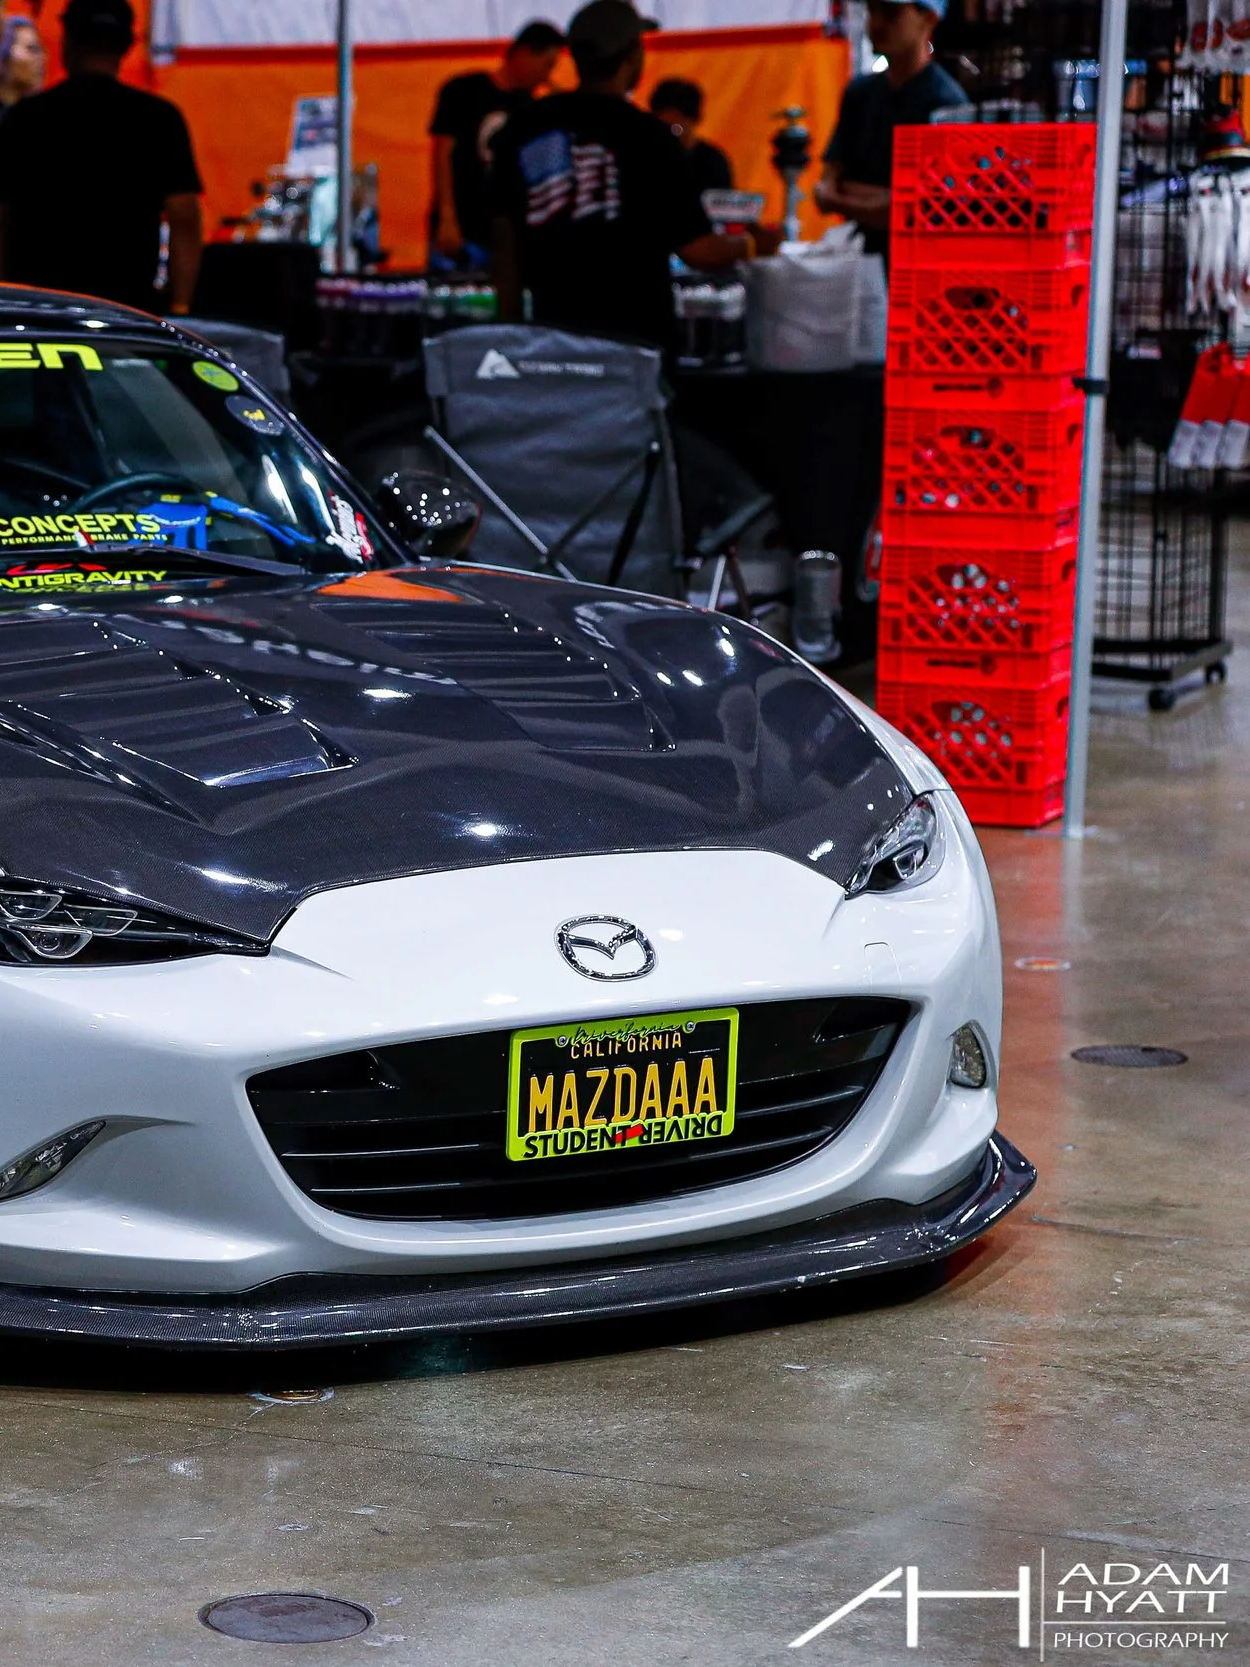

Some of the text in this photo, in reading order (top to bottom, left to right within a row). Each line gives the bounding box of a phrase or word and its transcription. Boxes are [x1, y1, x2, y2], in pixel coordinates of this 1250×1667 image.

[133, 533, 168, 541] PARTS
[570, 1031, 682, 1059] CALIFORNIA
[528, 1056, 718, 1133] MAZDAAA
[523, 1113, 724, 1159] STUDENT DRIVER
